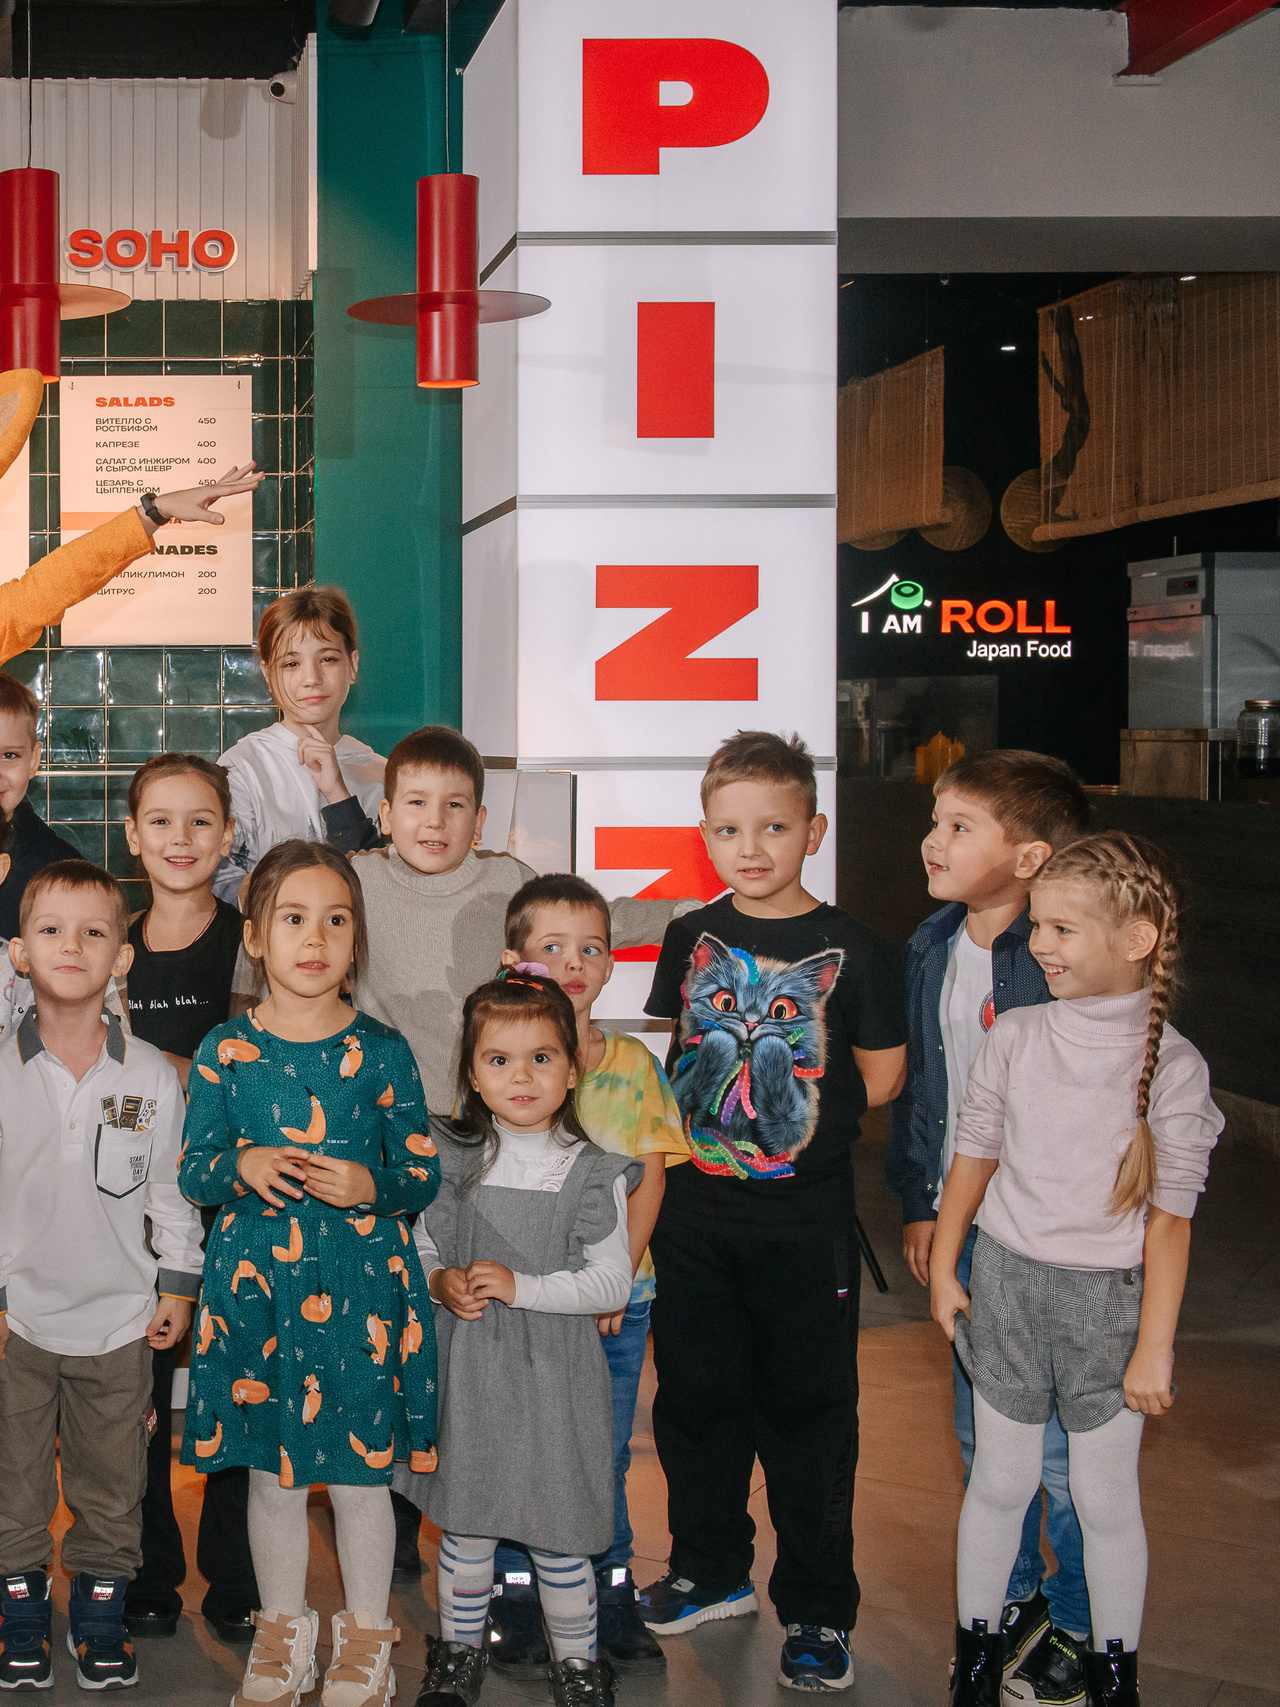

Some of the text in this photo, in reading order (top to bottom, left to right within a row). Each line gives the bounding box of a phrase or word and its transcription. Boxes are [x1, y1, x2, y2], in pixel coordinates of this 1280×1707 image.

[68, 228, 235, 269] SOHO
[95, 396, 174, 408] SALADS
[95, 486, 160, 494] ЦЫПЛЕНКОМ
[150, 544, 218, 556] NADES
[860, 598, 1072, 634] I AM ROLL
[966, 640, 1072, 662] Japan Food
[149, 999, 169, 1010] blah
[129, 1154, 146, 1164] START
[132, 1168, 144, 1176] DAY
